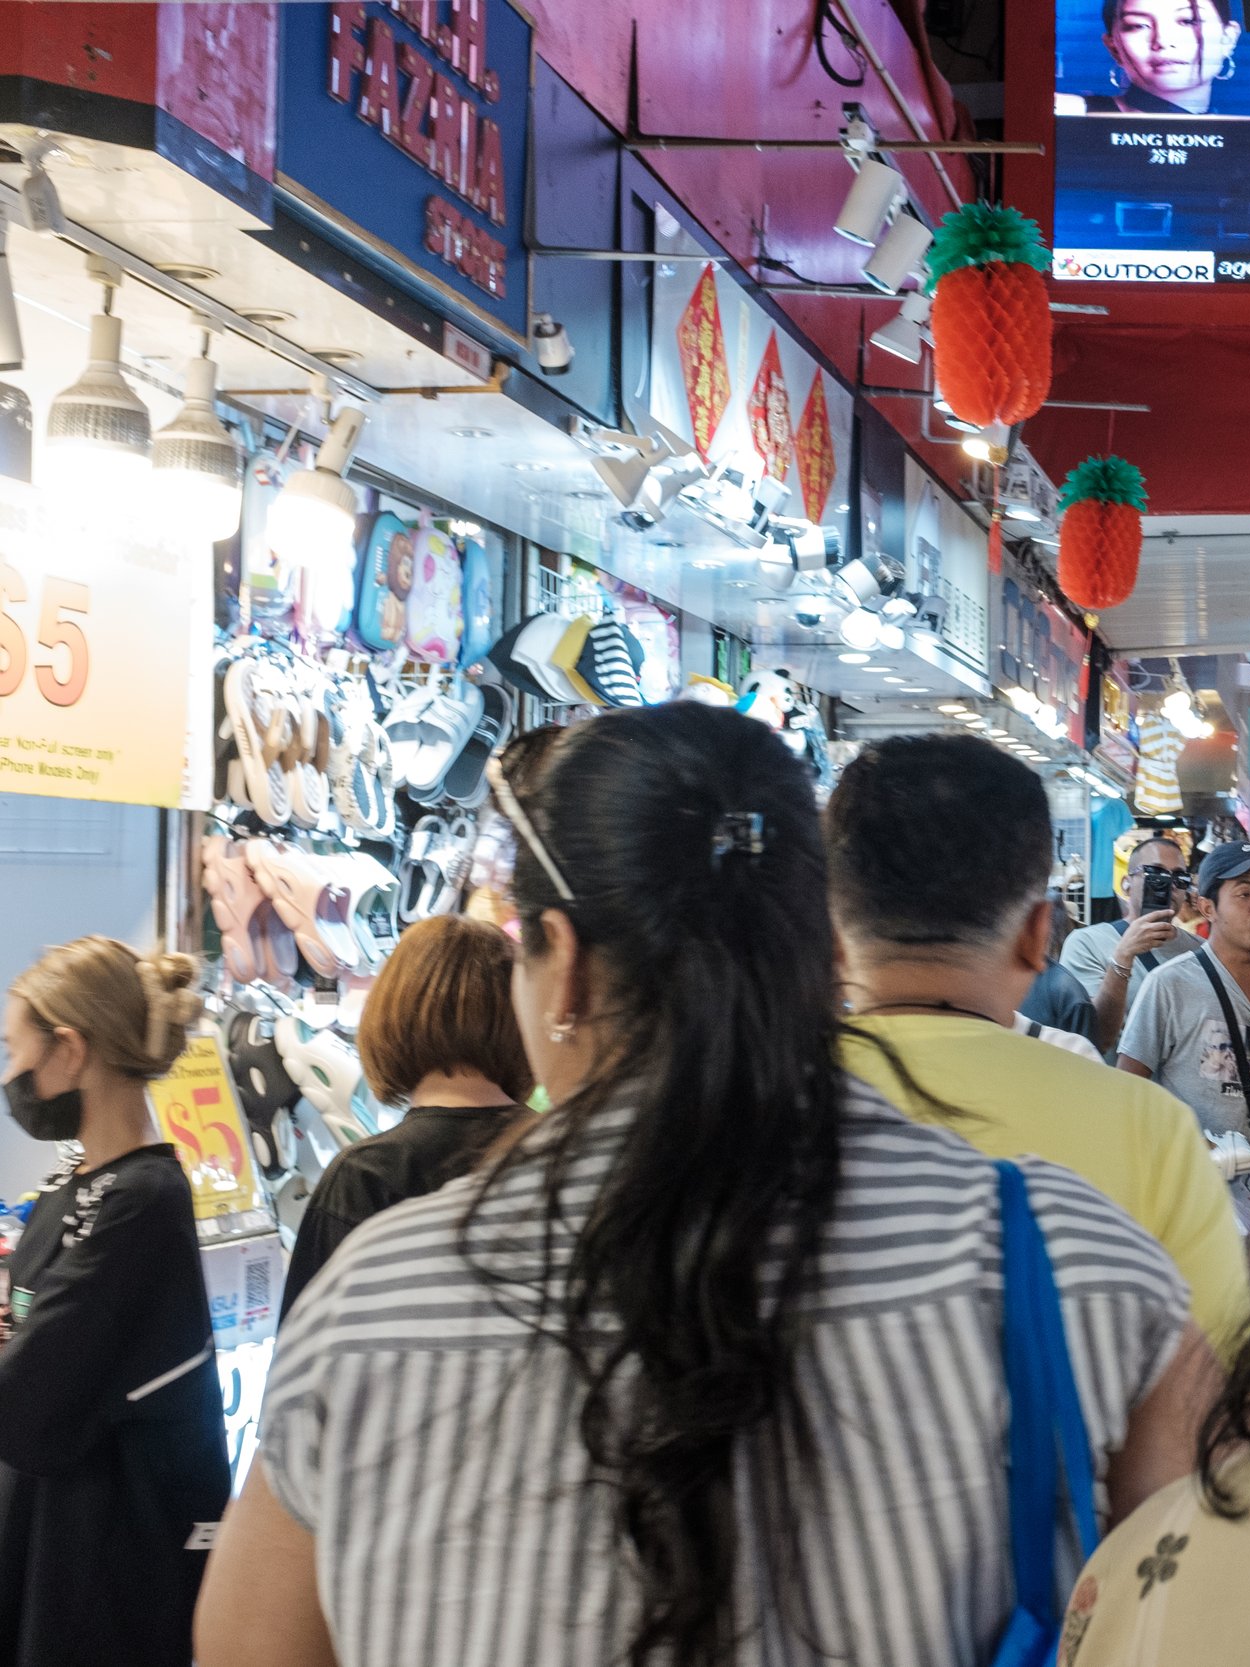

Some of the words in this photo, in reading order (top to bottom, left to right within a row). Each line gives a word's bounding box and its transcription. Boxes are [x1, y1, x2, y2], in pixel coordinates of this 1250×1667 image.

[327, 0, 506, 228] FAZRIA
[1110, 132, 1162, 146] FANG
[1166, 134, 1224, 148] RONG
[1083, 263, 1209, 281] OUTDOOR
[166, 1086, 245, 1182] $5
